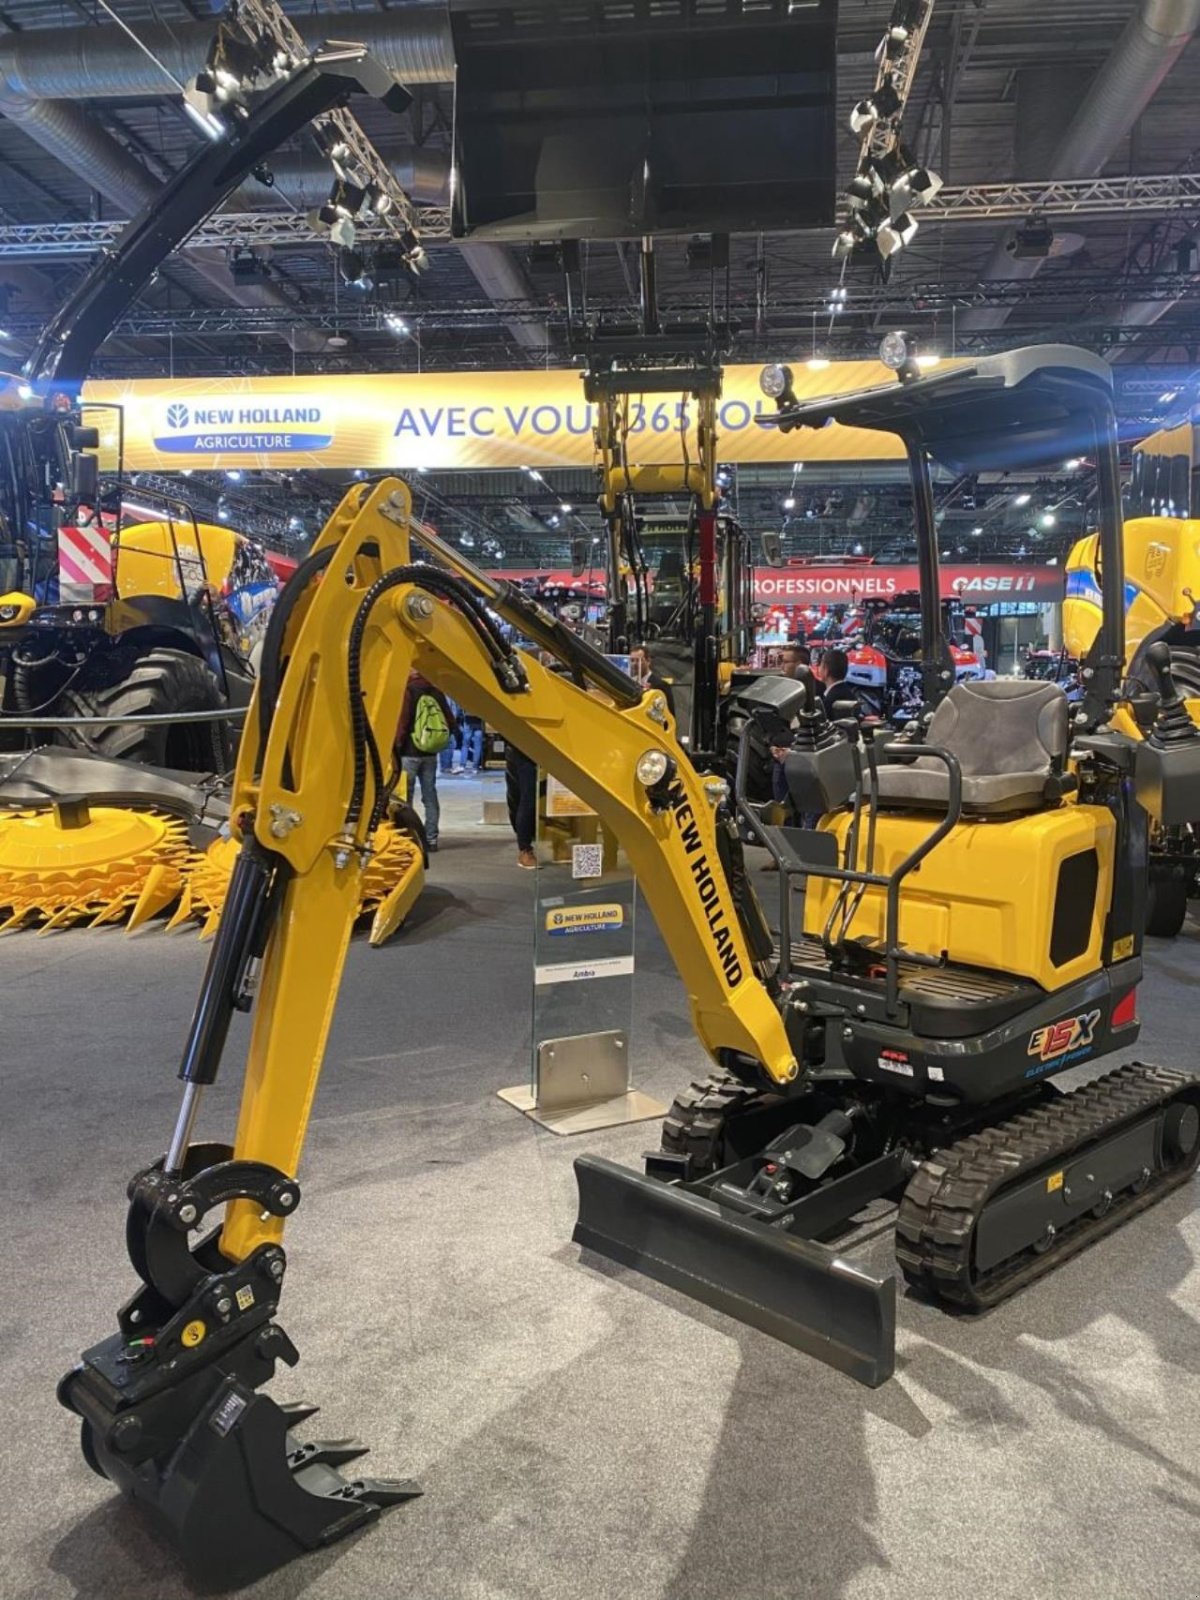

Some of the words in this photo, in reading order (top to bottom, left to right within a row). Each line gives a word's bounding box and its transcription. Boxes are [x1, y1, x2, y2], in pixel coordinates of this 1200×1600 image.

[194, 409, 234, 425] NEW
[239, 408, 321, 424] HOLLAND
[394, 406, 495, 437] AVEC
[504, 405, 601, 436] VOU
[630, 402, 691, 434] 365
[194, 434, 292, 449] AGRICULTURE
[952, 576, 1013, 591] CASE
[565, 913, 582, 923] NEW
[583, 910, 618, 920] HOLLAND
[691, 854, 743, 988] HOLLAND
[564, 923, 606, 934] AGRICULTURE
[1027, 1008, 1101, 1061] E15X
